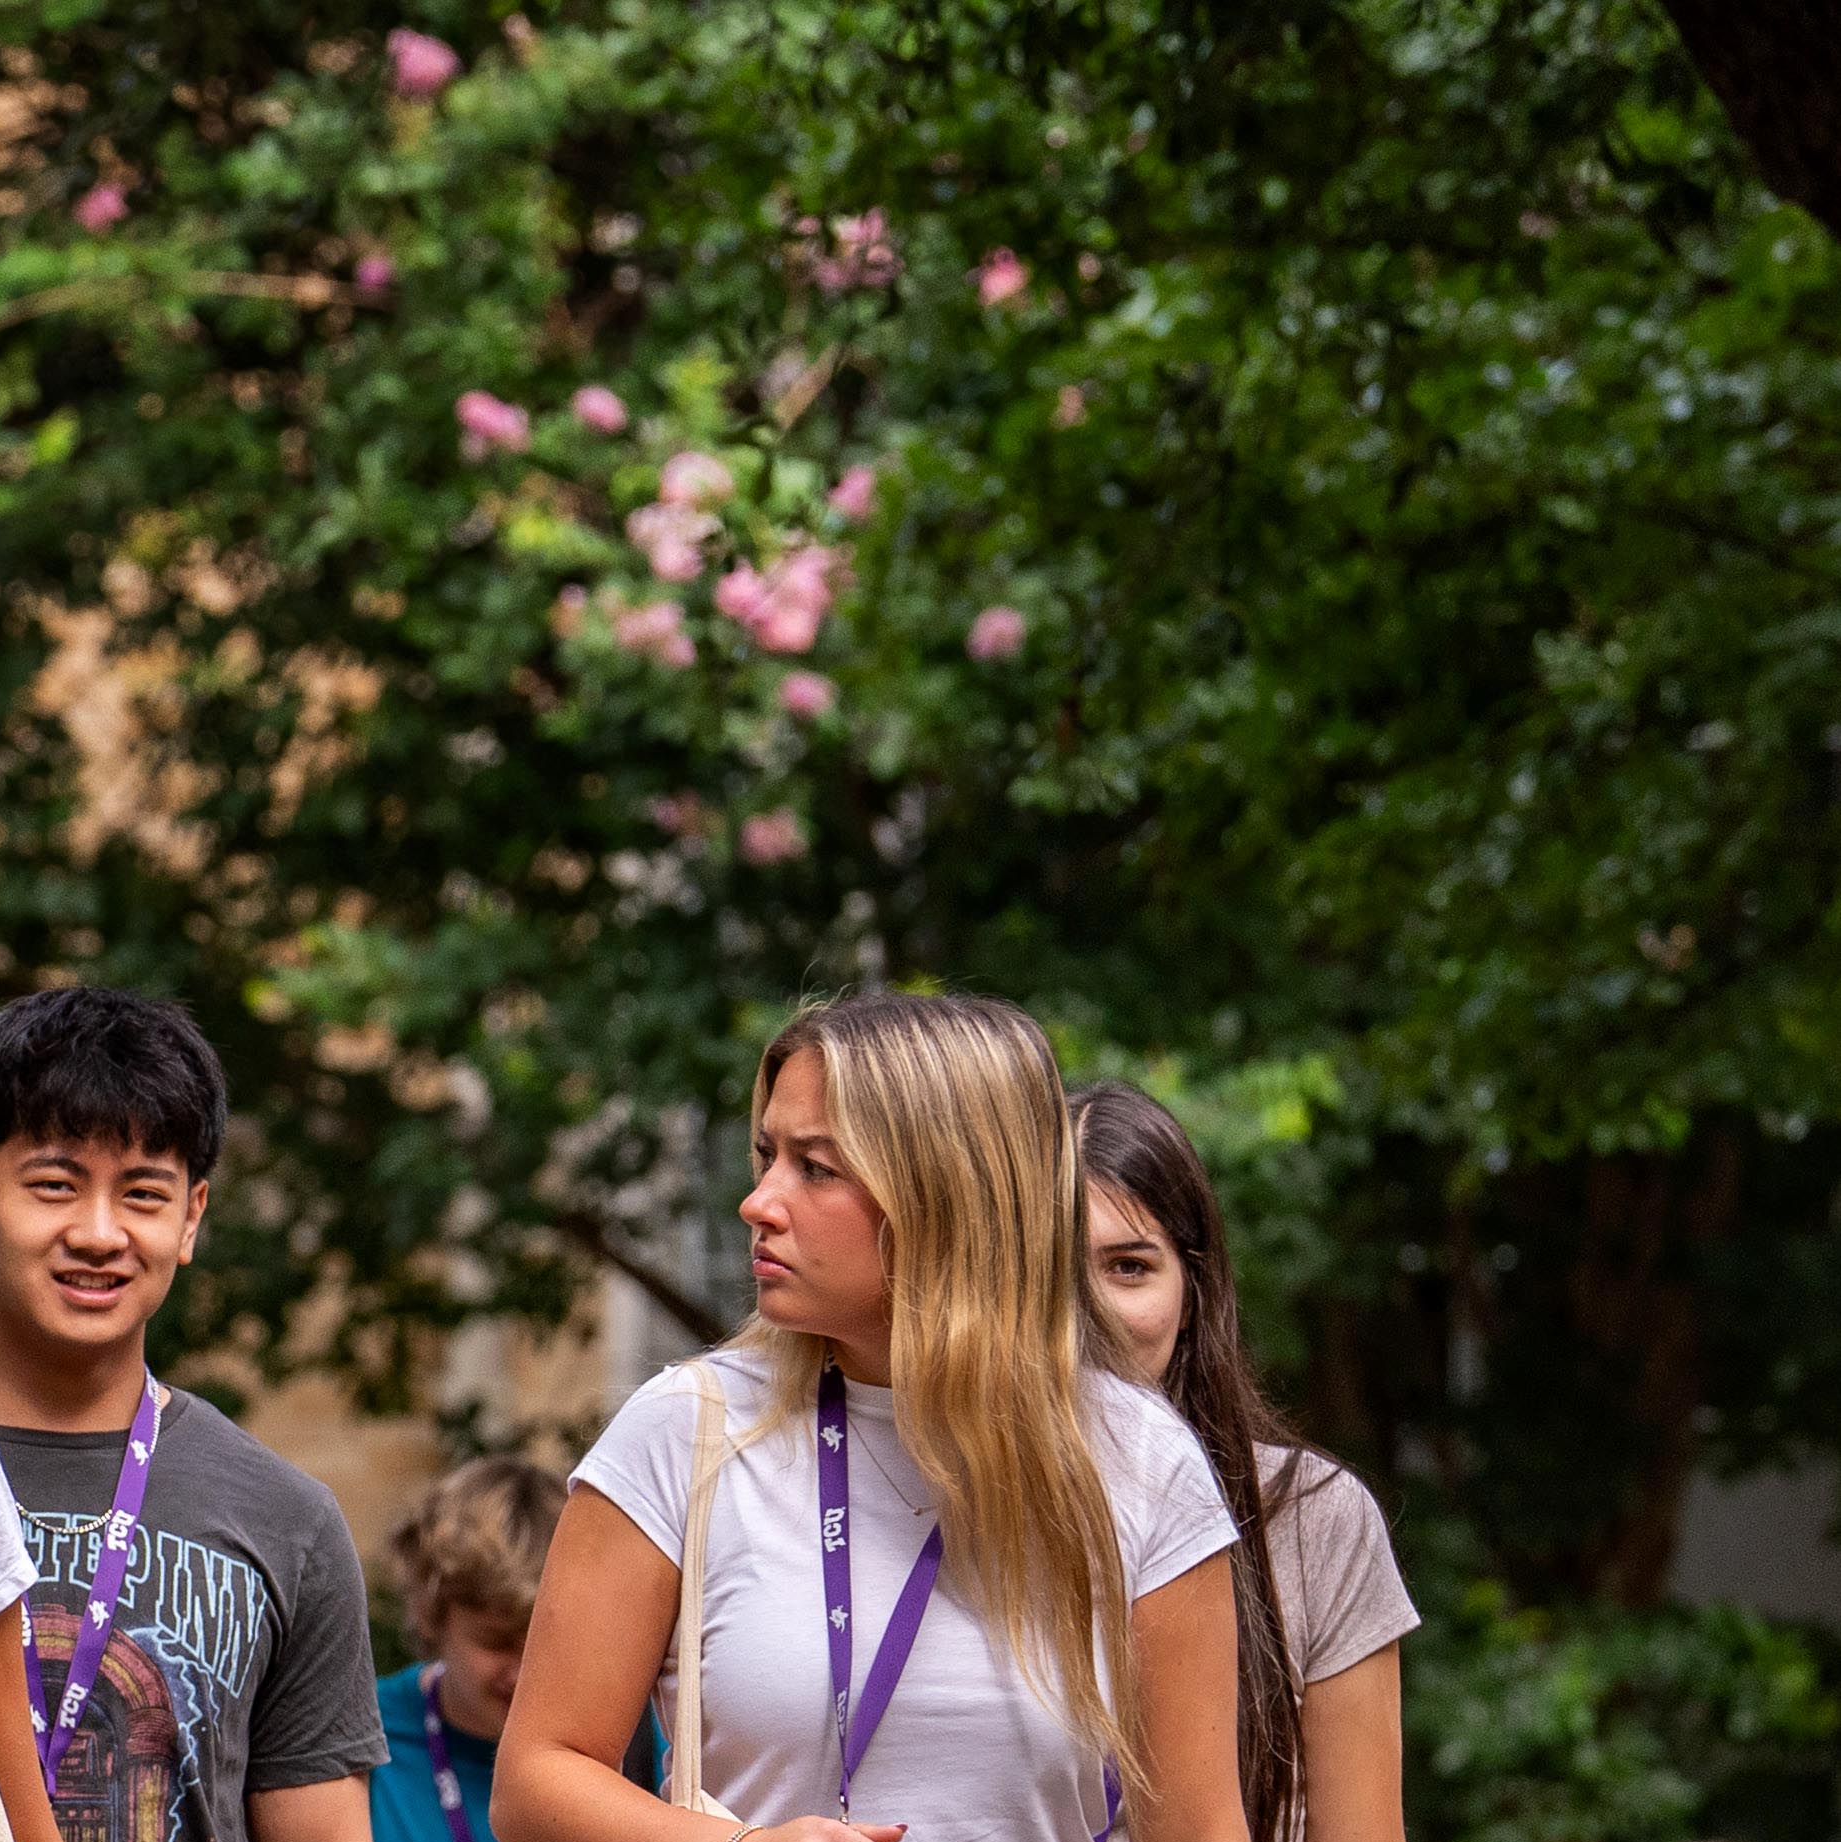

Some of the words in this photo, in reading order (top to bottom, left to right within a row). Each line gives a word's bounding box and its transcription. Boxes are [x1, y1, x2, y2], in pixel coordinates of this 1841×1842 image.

[107, 1509, 136, 1551] TCU
[823, 1506, 846, 1553] TCU
[155, 1529, 268, 1699] INN
[59, 1682, 89, 1729] TCU
